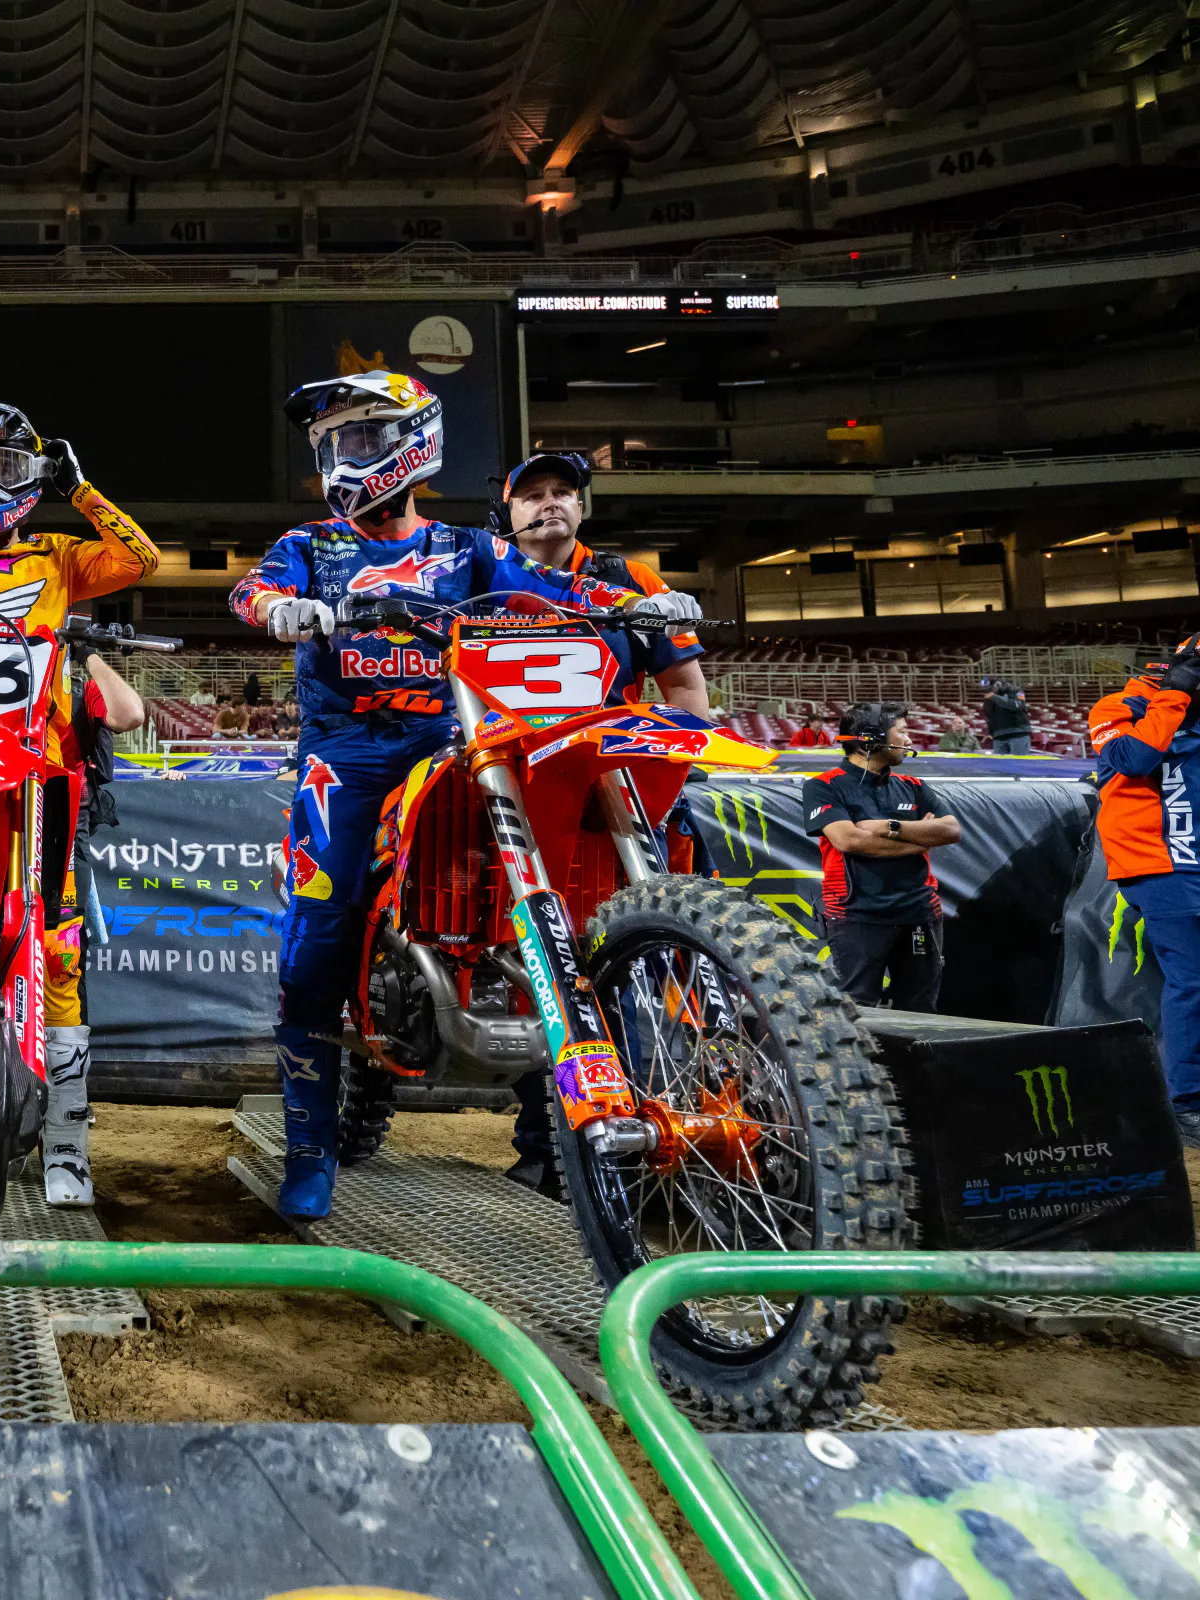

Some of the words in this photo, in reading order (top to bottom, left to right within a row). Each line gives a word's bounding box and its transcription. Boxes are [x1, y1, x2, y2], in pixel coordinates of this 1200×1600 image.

[939, 148, 996, 176] 404
[649, 202, 696, 224] 403
[170, 221, 206, 241] 401
[402, 220, 442, 239] 402
[363, 453, 409, 498] Red
[405, 432, 438, 473] Bull
[630, 618, 667, 628] ARC
[340, 647, 401, 679] Red
[402, 648, 442, 680] Bu
[486, 641, 603, 710] 3
[352, 688, 443, 714] KTM
[479, 726, 495, 735] LOVE
[495, 718, 514, 729] MOTO
[810, 804, 833, 821] WP
[118, 877, 264, 891] ENERGY
[520, 937, 562, 1030] MOTOREX
[549, 921, 599, 1033] DUNP
[34, 938, 45, 1067] DUNLOP
[563, 1045, 614, 1059] ACERBIS
[1004, 1142, 1113, 1167] MONSTER
[1023, 1163, 1099, 1176] ENERGY
[962, 1170, 1167, 1207] SUPERCROSS
[965, 1178, 990, 1190] AMA
[1008, 1195, 1132, 1221] CHAMPIONSHIP
